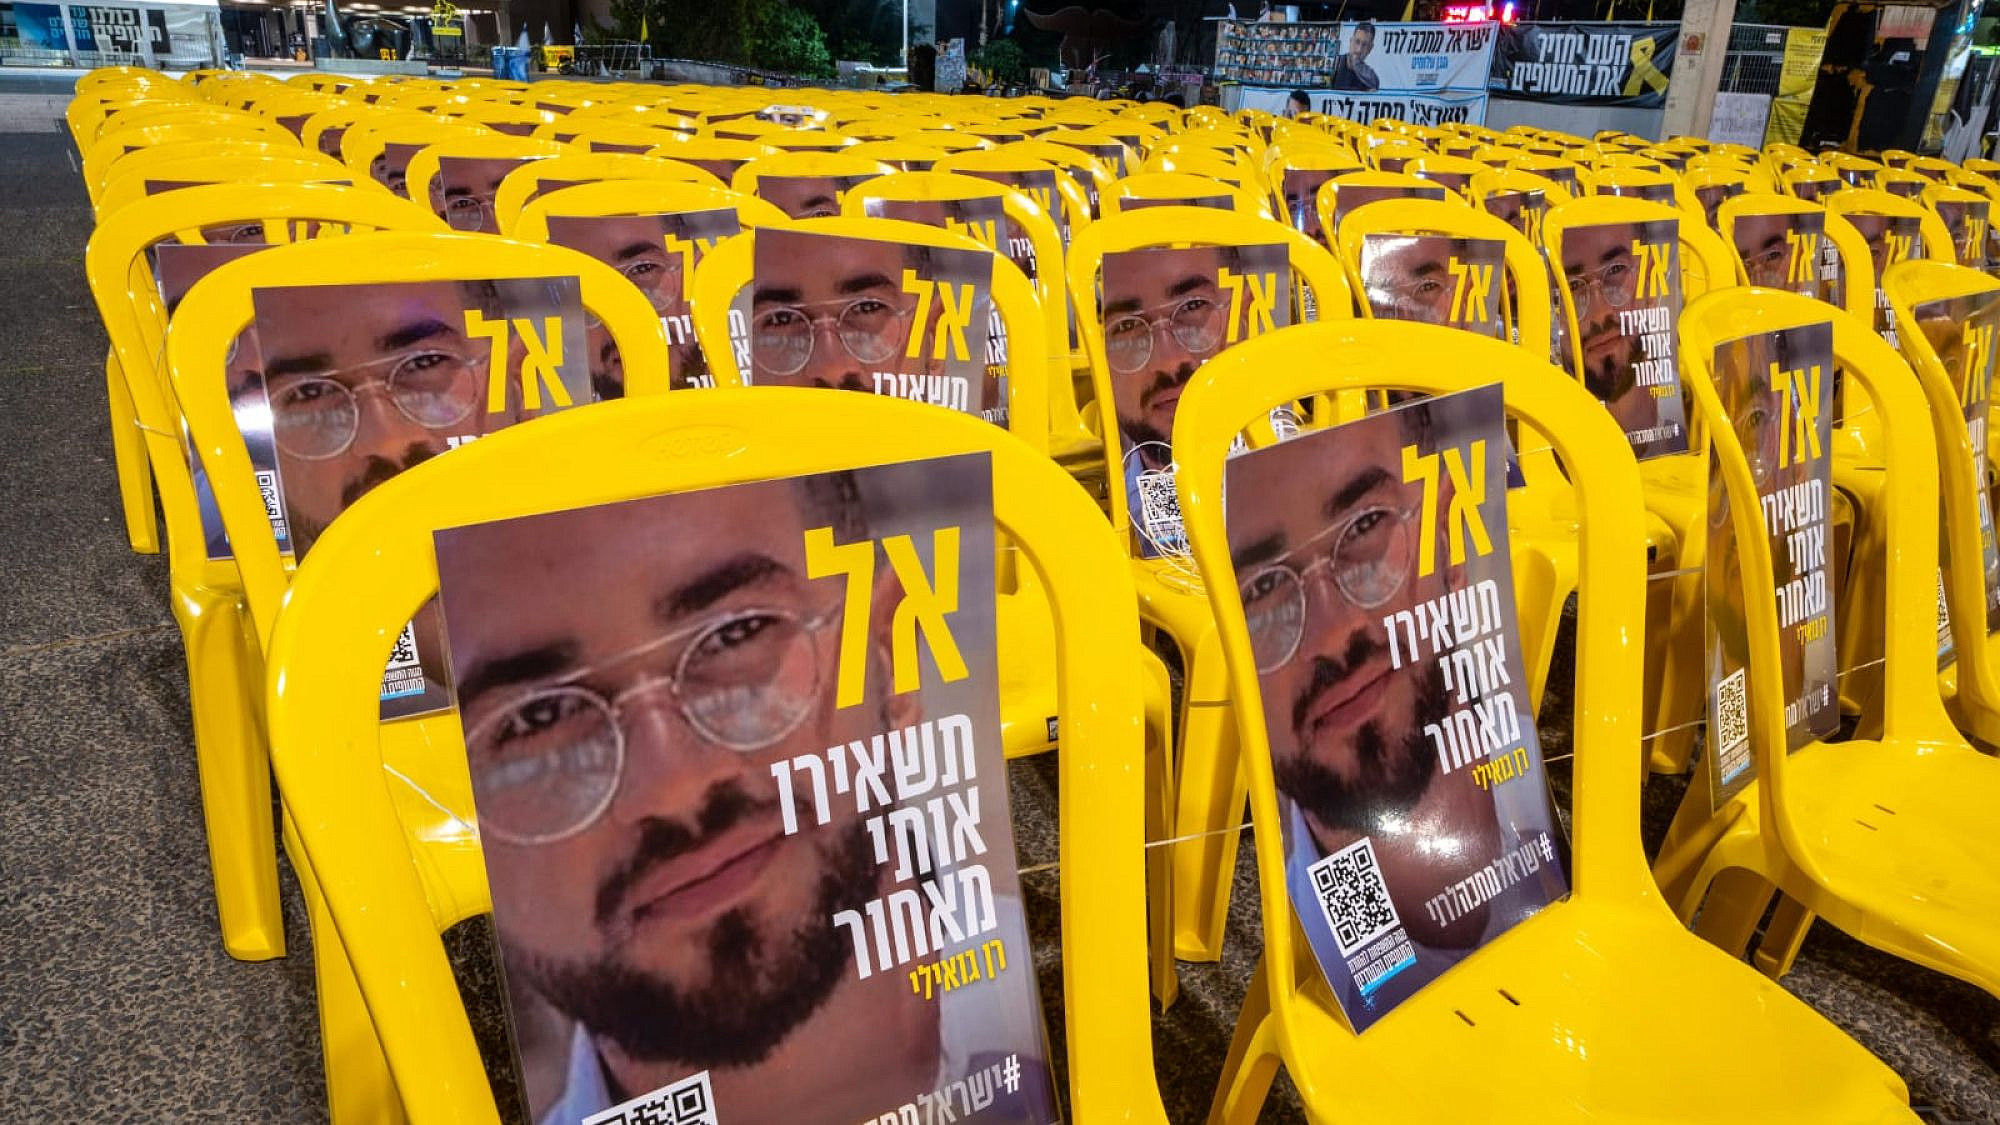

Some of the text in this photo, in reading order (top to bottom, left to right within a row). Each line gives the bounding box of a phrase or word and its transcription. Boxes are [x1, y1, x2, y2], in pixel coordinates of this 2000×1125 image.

[89, 8, 135, 25] כולנו
[1383, 27, 1491, 54] ישראל מחכה לרני
[1511, 62, 1627, 96] את החטופים
[1537, 33, 1633, 66] העם יחזיר
[1786, 228, 1816, 284] אל
[1885, 229, 1912, 269] אל
[1965, 214, 1985, 260] אל
[1448, 255, 1493, 323] אל
[1632, 239, 1671, 300] אל
[902, 269, 975, 361] אל
[1218, 267, 1276, 343] אל
[1620, 306, 1671, 336] תשאירו
[464, 309, 574, 414] אל
[1631, 358, 1673, 387] מאחור
[1640, 333, 1672, 360] אותי
[1962, 319, 1994, 409] אל
[872, 371, 969, 412] תשאירו
[1769, 362, 1822, 470] אל
[1402, 439, 1494, 578] אל
[1761, 478, 1825, 537] תשאירו
[1786, 523, 1826, 576] אותי
[804, 526, 970, 709] אל
[1384, 579, 1502, 671] תשאירו
[1776, 570, 1826, 629] מאחור
[1439, 634, 1511, 704] אותי
[1425, 691, 1522, 775] מאחור
[1785, 683, 1829, 730] #ישראלמח
[771, 714, 977, 837] תשאירו
[1472, 746, 1529, 791] רן גואילי
[865, 787, 988, 883] אותי
[1425, 832, 1554, 928] #ישראלמחכהלרני
[833, 864, 999, 980] מאחור
[909, 938, 1007, 1001] רן גואילי
[863, 1054, 1021, 1125] #ישראלמ
